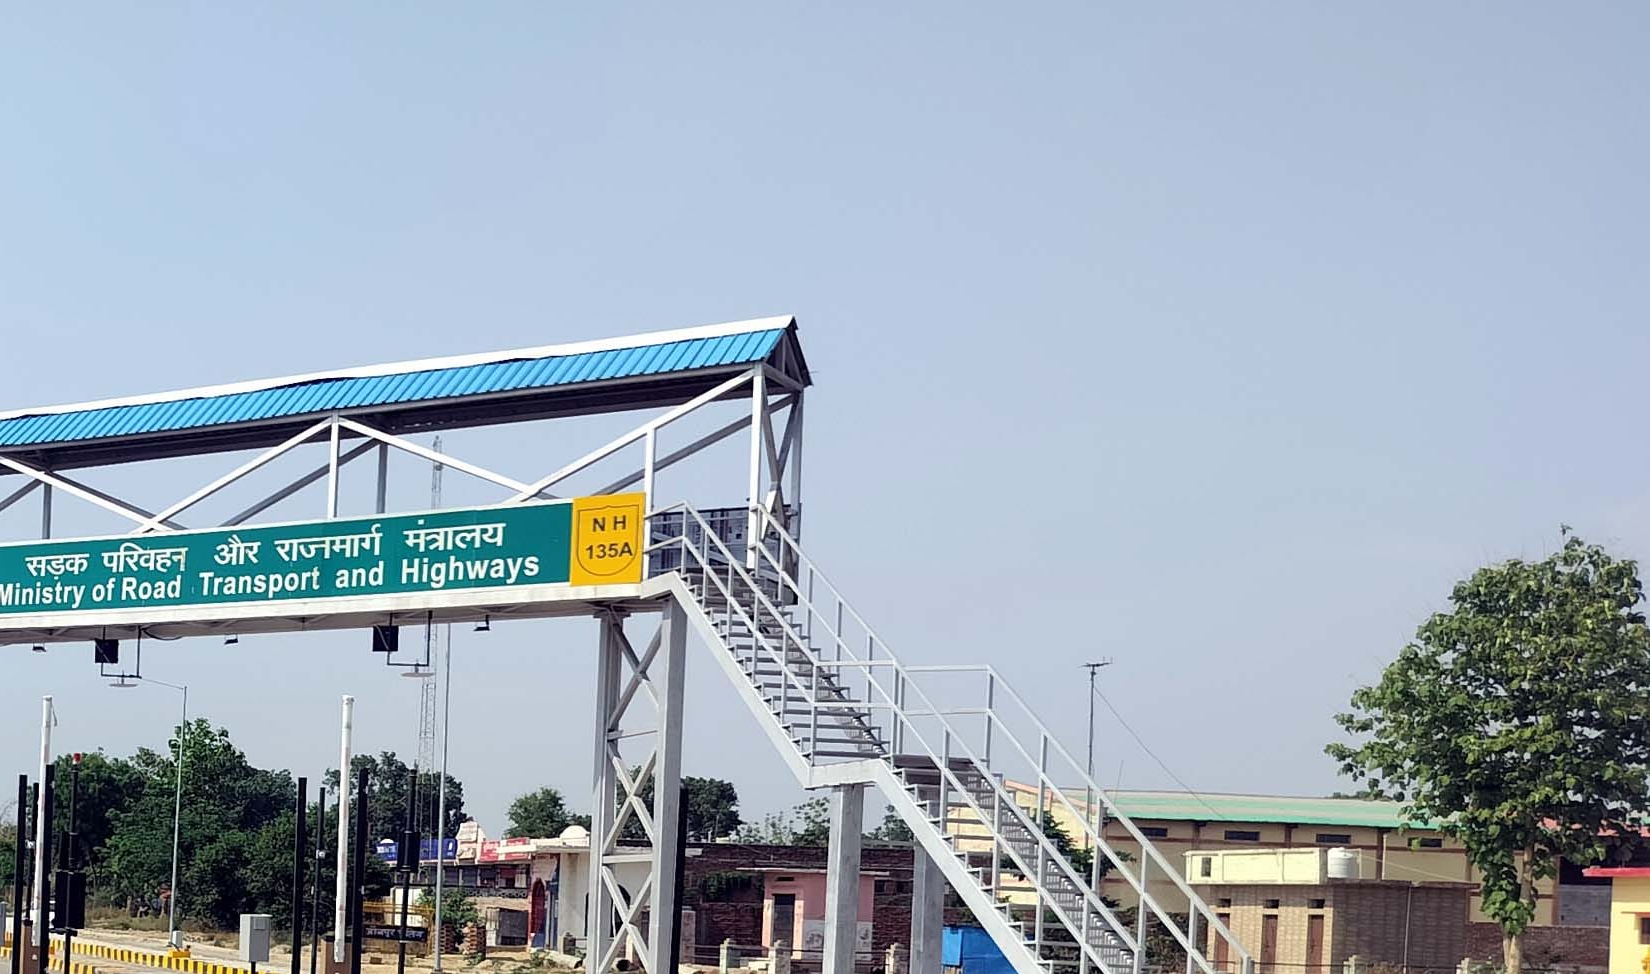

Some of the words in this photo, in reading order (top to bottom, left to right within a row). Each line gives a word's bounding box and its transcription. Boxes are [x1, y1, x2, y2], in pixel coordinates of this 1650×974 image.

[25, 552, 89, 580] सड़क
[101, 542, 189, 573] परिवहन
[213, 534, 261, 566] और
[273, 523, 383, 562] राजमार्ग
[403, 519, 507, 553] मंत्रालय
[585, 541, 633, 560] 135A
[92, 577, 115, 602] of
[121, 575, 182, 601] Road
[199, 565, 320, 599] Transport
[335, 560, 384, 588] and
[401, 553, 540, 588] Highways
